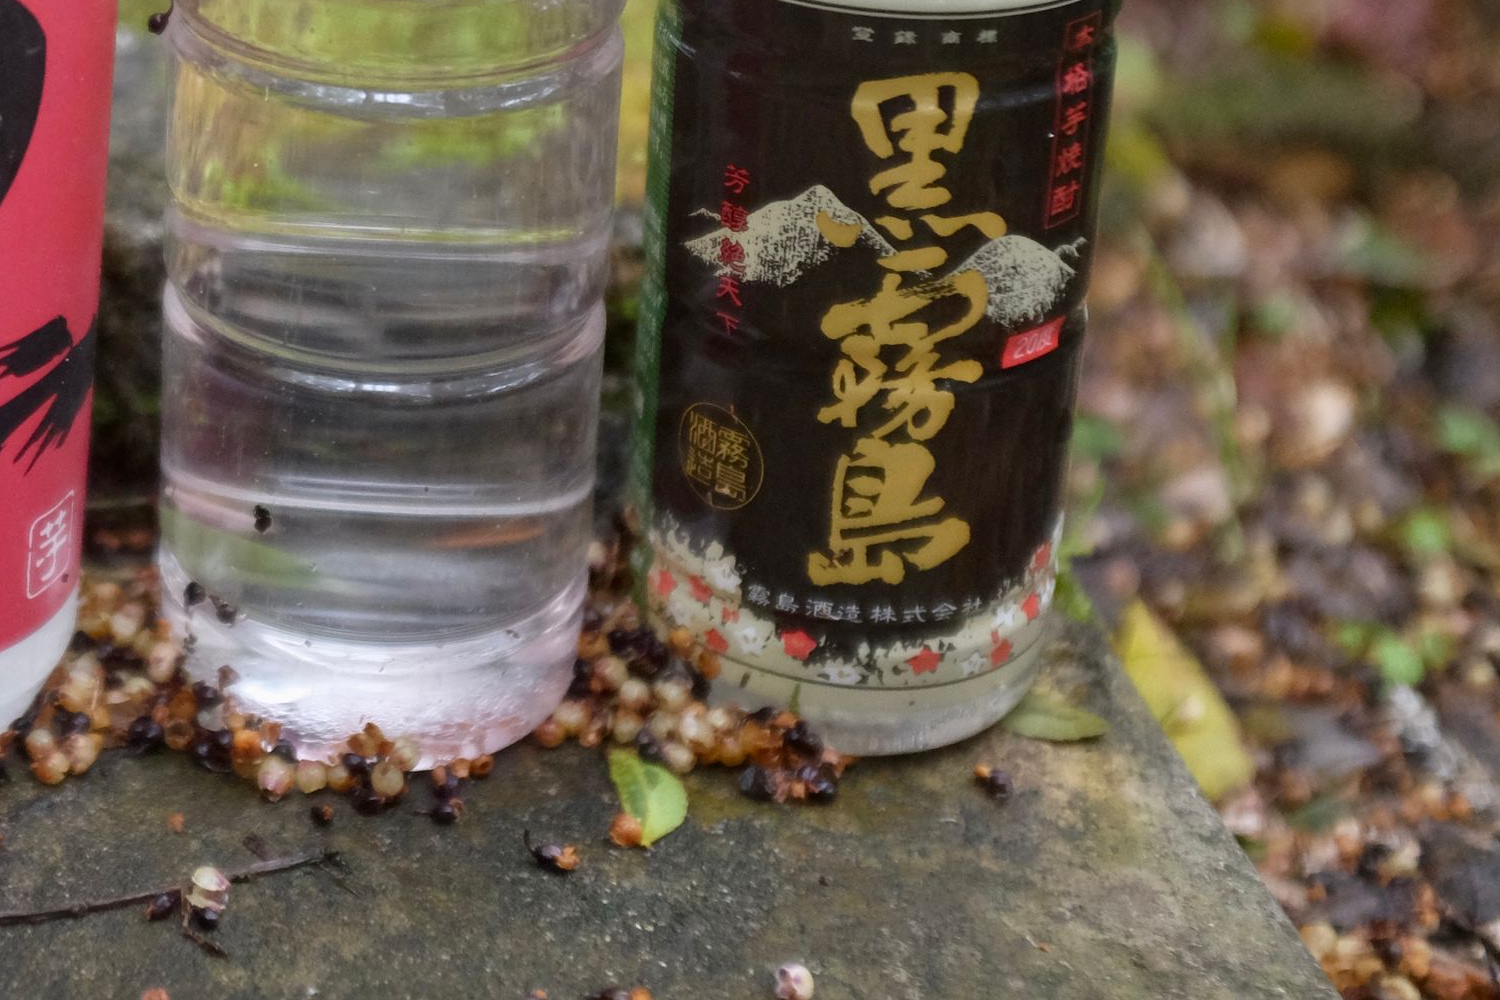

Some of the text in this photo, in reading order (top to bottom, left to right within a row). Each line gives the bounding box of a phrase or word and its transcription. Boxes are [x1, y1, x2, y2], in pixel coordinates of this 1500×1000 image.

[807, 71, 1008, 586] 黒霧島
[35, 510, 68, 582] 芋
[748, 583, 982, 625] 霧島酒造株式会社
